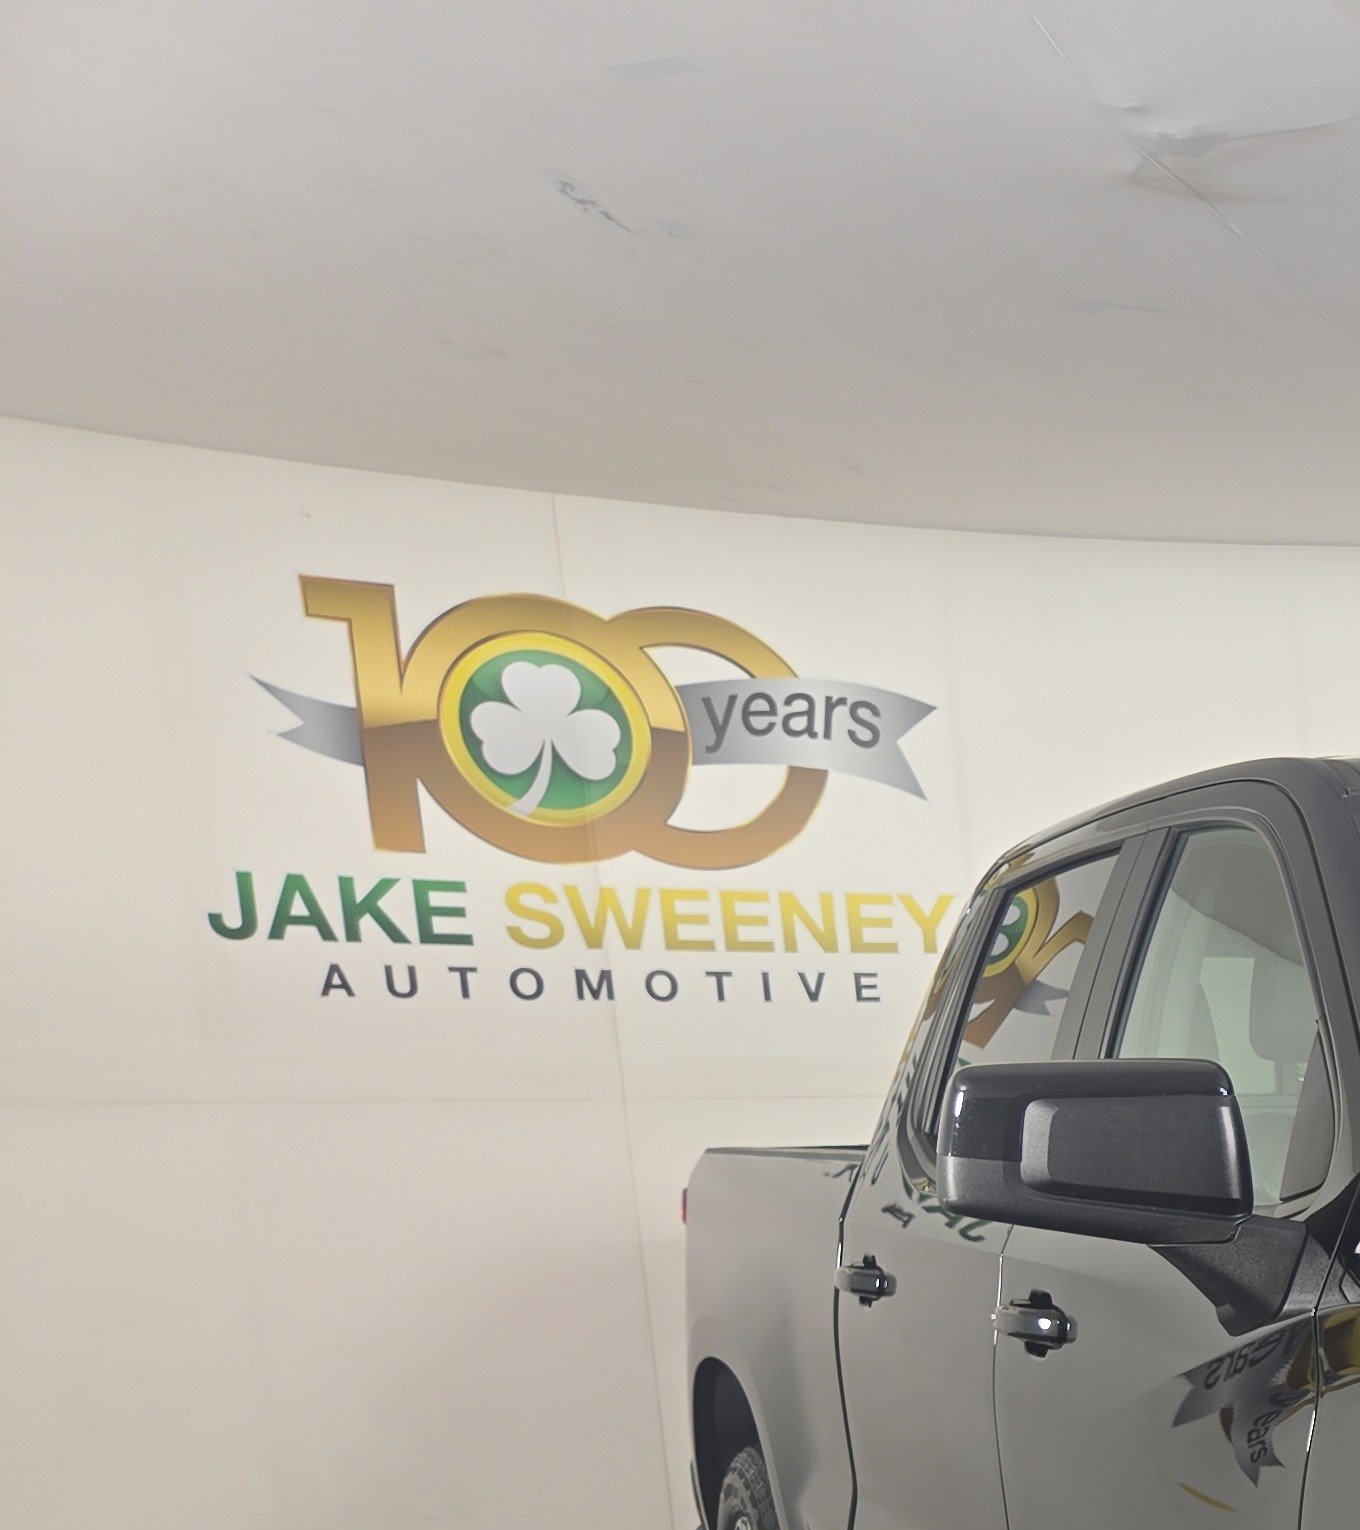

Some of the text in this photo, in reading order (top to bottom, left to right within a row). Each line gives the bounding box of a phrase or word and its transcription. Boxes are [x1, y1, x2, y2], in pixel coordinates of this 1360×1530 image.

[298, 574, 884, 870] 100 years
[206, 870, 955, 955] JAKE SWEENEY
[319, 963, 882, 1003] AUTOMOTIVE
